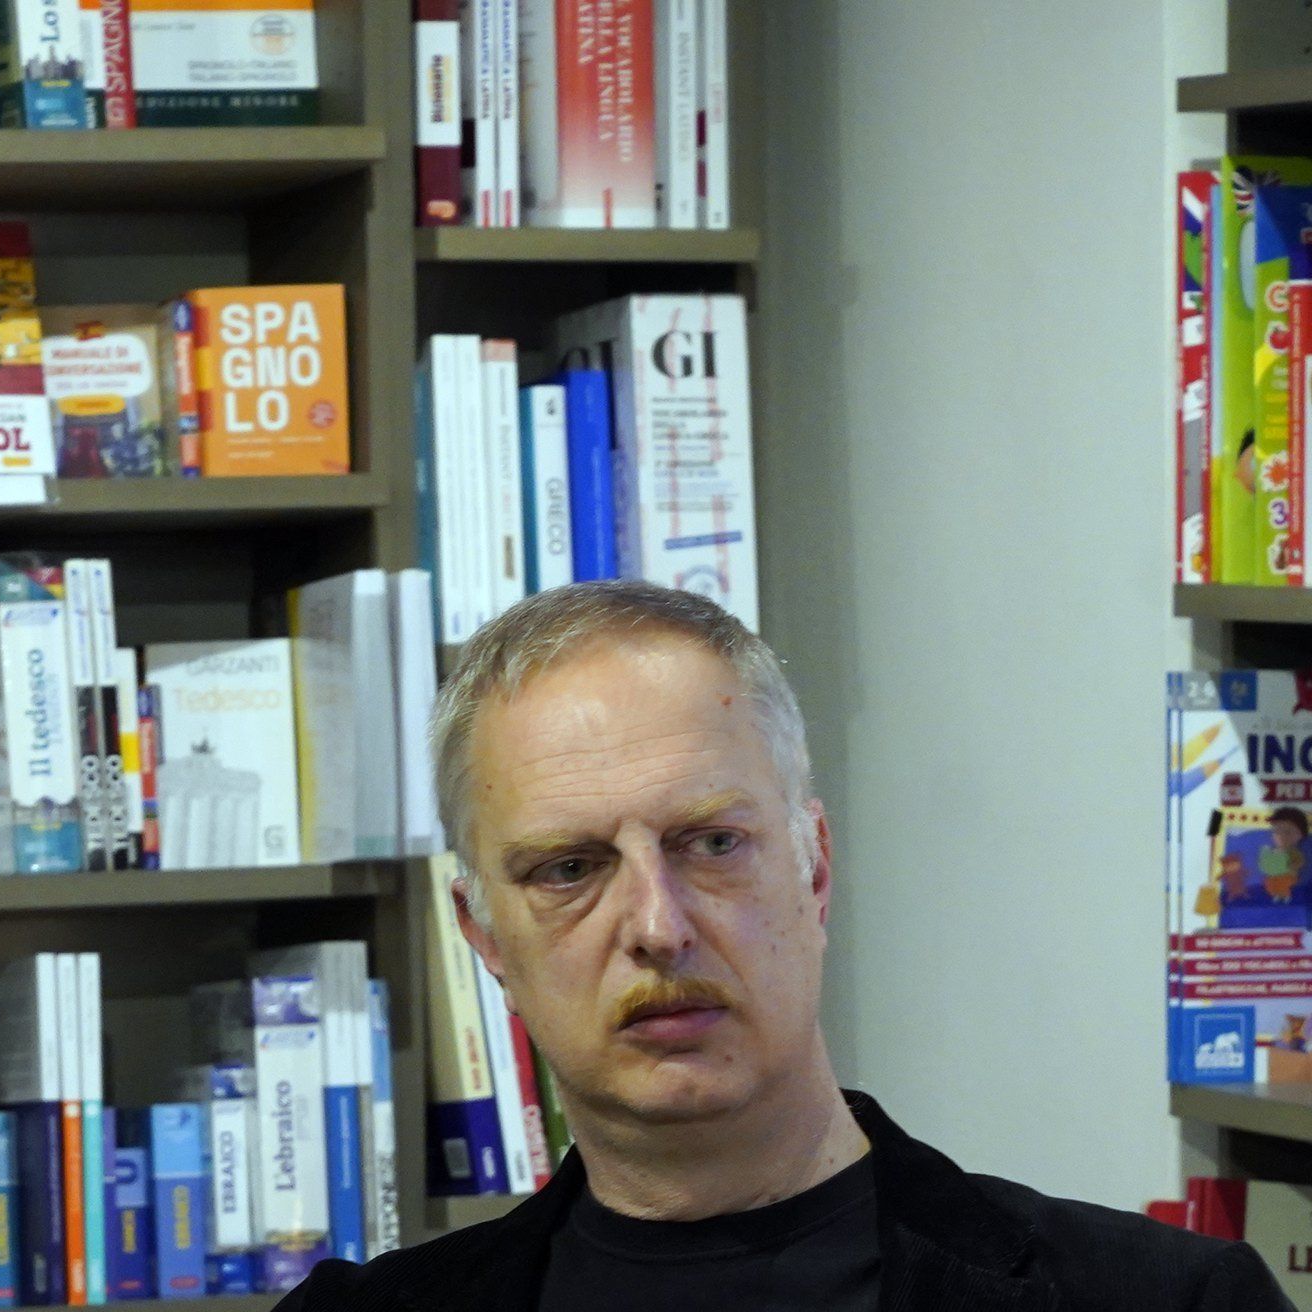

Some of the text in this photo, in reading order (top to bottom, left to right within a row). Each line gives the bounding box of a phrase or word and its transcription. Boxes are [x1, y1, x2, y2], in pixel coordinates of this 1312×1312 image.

[220, 300, 320, 345] SPA
[220, 345, 322, 389] GNO
[650, 329, 718, 380] GI
[224, 389, 291, 434] LO
[545, 477, 566, 556] GRECO
